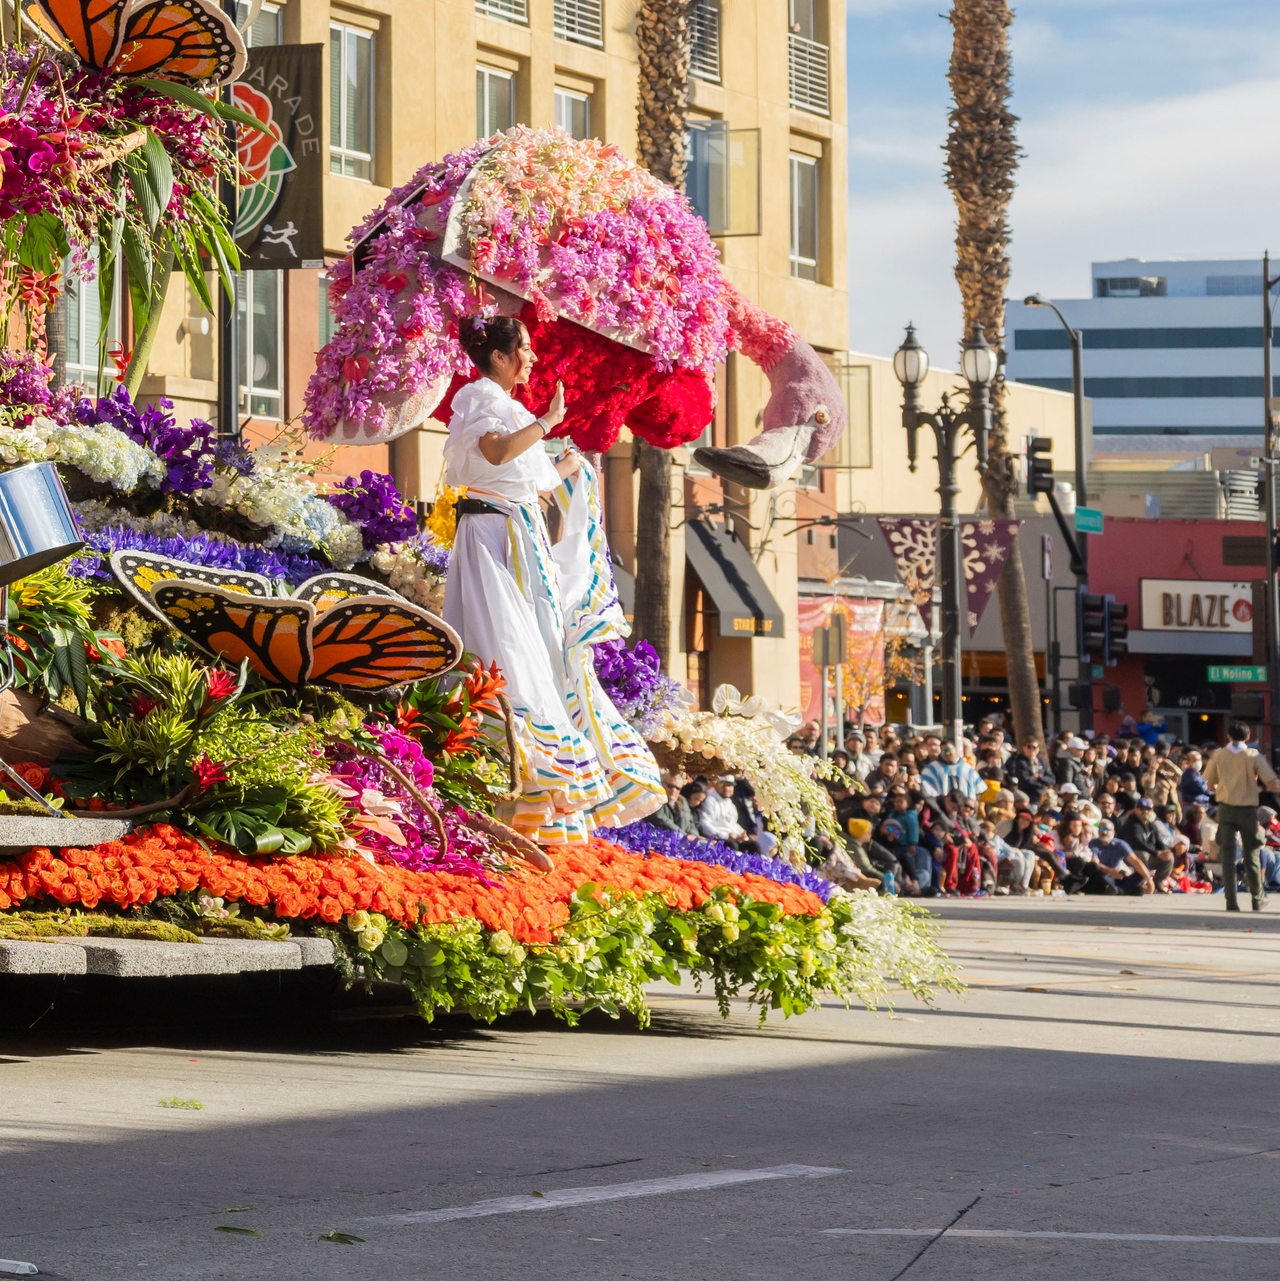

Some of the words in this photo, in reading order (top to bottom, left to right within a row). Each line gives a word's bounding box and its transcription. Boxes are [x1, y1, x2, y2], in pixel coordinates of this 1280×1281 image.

[1161, 592, 1230, 628] BLAZE
[1211, 667, 1219, 680] El
[1222, 668, 1253, 680] Molino
[1179, 696, 1198, 707] 667
